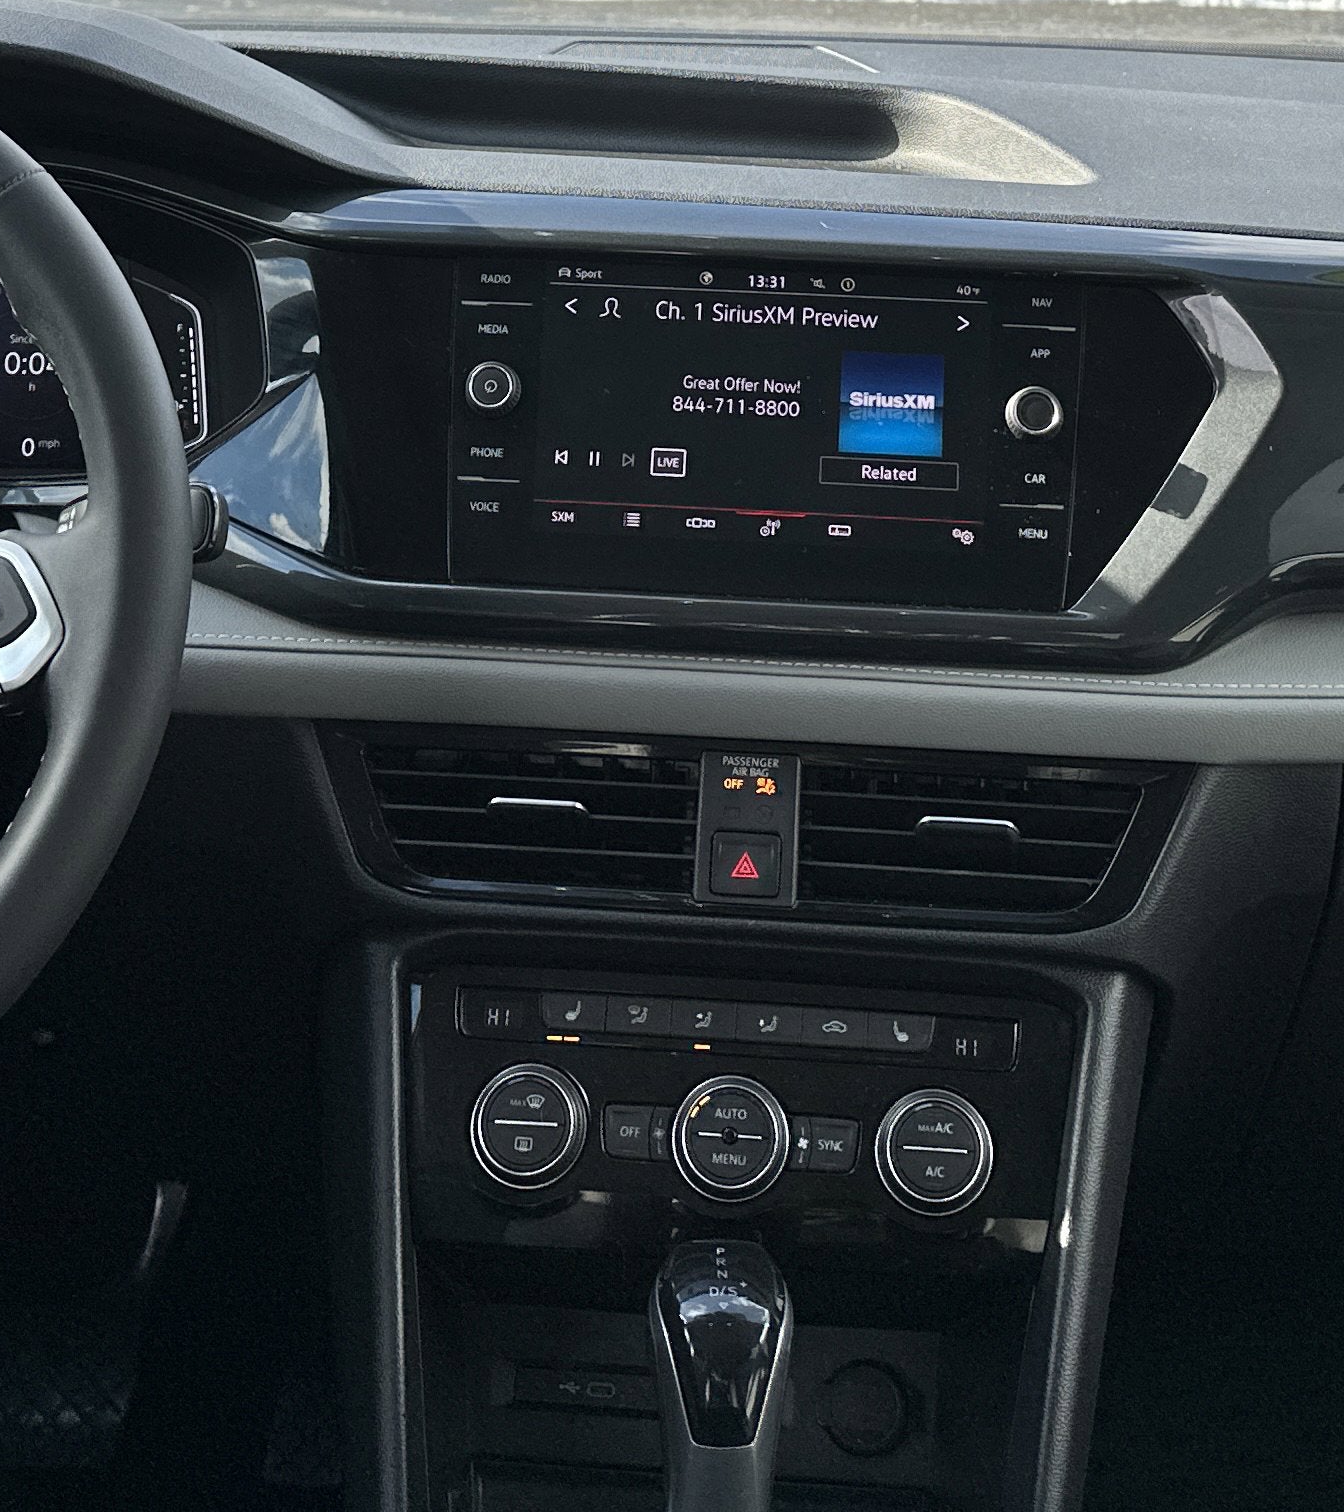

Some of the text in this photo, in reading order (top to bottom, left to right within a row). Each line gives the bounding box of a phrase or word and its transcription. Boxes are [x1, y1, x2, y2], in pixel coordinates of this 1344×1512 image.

[480, 273, 512, 285] RADIO
[575, 268, 603, 280] Sport
[748, 274, 786, 289] 13:31
[1031, 297, 1053, 308] NAV
[656, 300, 879, 329] Ch. 1 SiriusXM Preview
[477, 323, 509, 335] MEDIA
[1030, 348, 1051, 359] APP
[683, 374, 801, 394] Great Offer Now!
[672, 395, 800, 417] 844-711-8800
[849, 391, 935, 410] SiriusXM
[21, 438, 35, 457] 0
[470, 446, 505, 458] PHONE
[656, 457, 680, 469] LIVE
[861, 464, 917, 482] Related
[1024, 473, 1046, 484] CAR
[469, 501, 501, 512] VOICE
[551, 511, 575, 523] SXM
[1018, 528, 1048, 540] MENU
[722, 755, 780, 768] PASSENGER
[731, 767, 770, 777] AIR BAG
[723, 778, 744, 790] OFF
[487, 1008, 510, 1026] HI
[955, 1039, 978, 1057] HI
[714, 1108, 747, 1120] AUTO
[619, 1125, 641, 1138] OFF
[934, 1121, 954, 1135] A/C
[817, 1139, 844, 1152] SYNC
[711, 1153, 747, 1166] MENU
[925, 1165, 945, 1179] A/C
[716, 1247, 725, 1255] P
[717, 1269, 728, 1279] N
[709, 1285, 738, 1297] D/S
